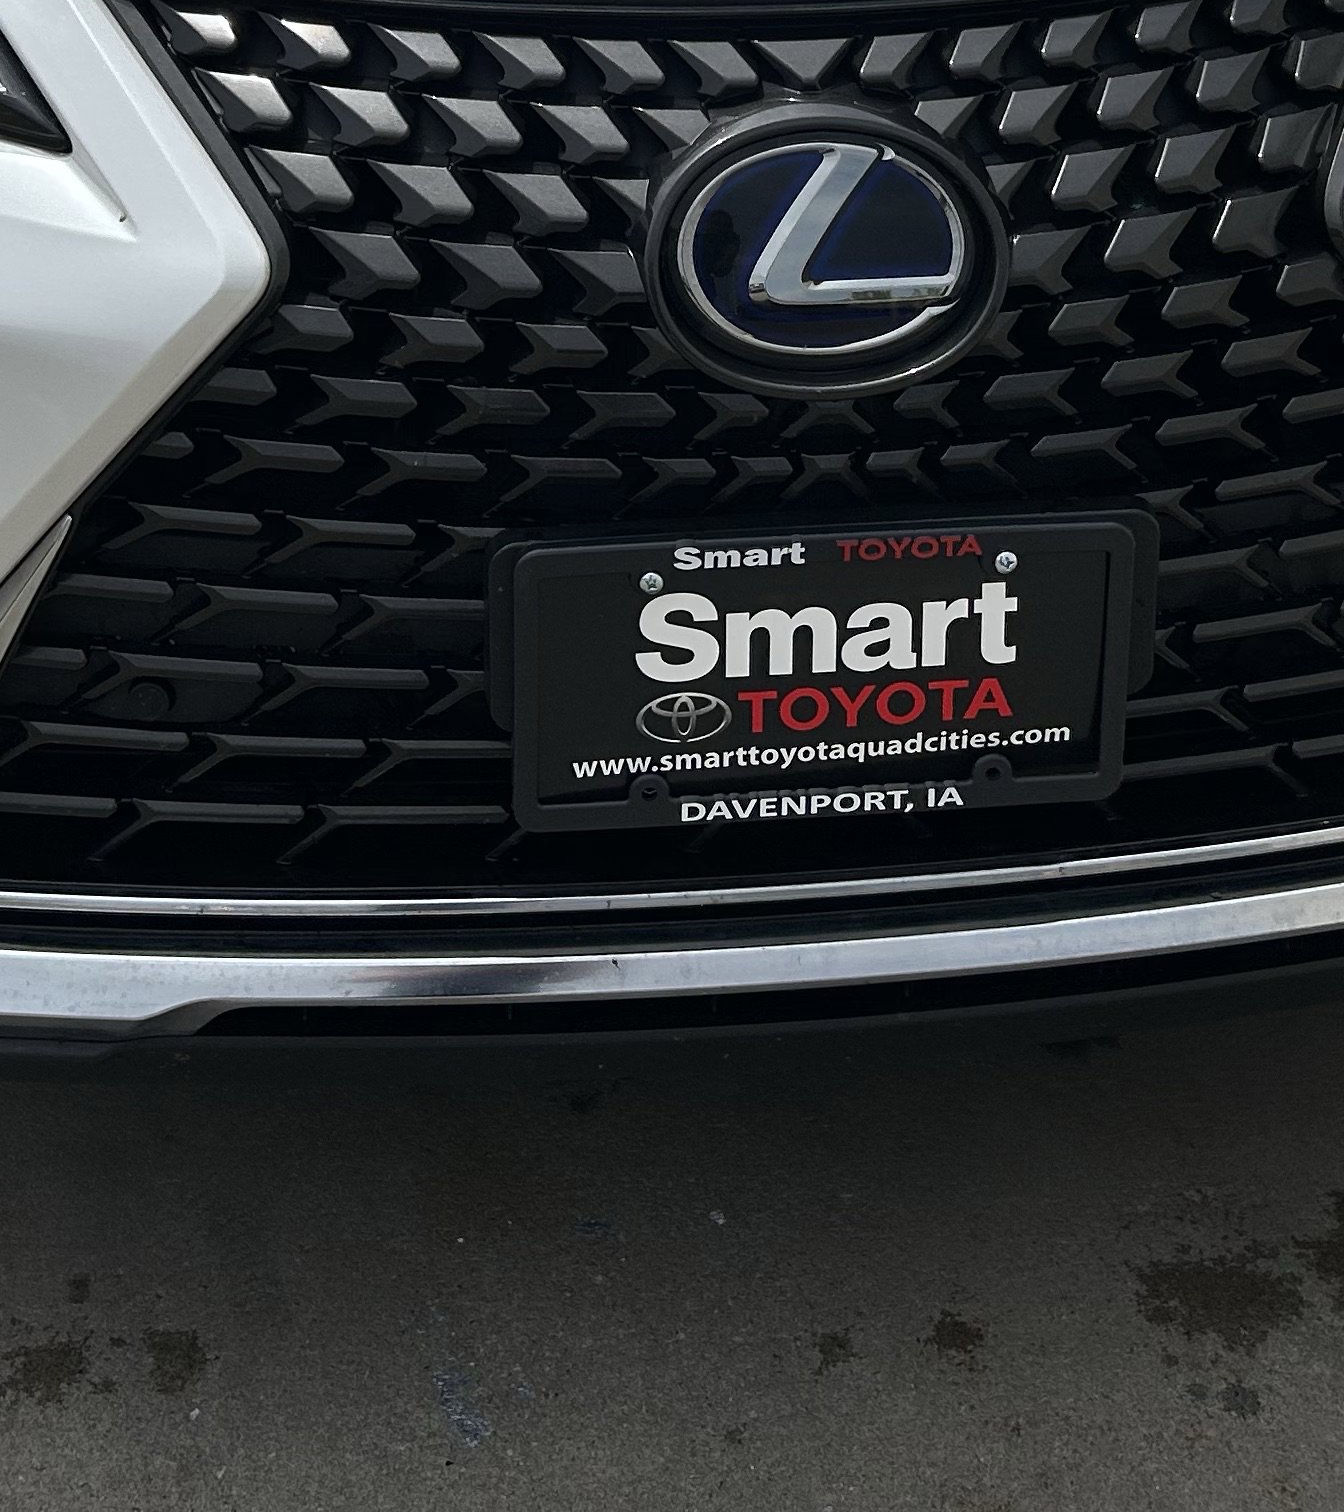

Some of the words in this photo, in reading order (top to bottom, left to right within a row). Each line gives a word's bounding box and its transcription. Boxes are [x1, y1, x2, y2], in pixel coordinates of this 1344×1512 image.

[672, 542, 807, 571] Smart
[836, 535, 983, 562] TOYOTA
[634, 581, 1018, 683] Smart
[737, 677, 1013, 733] TOYOTA
[572, 723, 1072, 779] www.smarttoyotaquadcities.com
[680, 789, 915, 823] DAVENPORT,
[927, 784, 964, 808] IA
